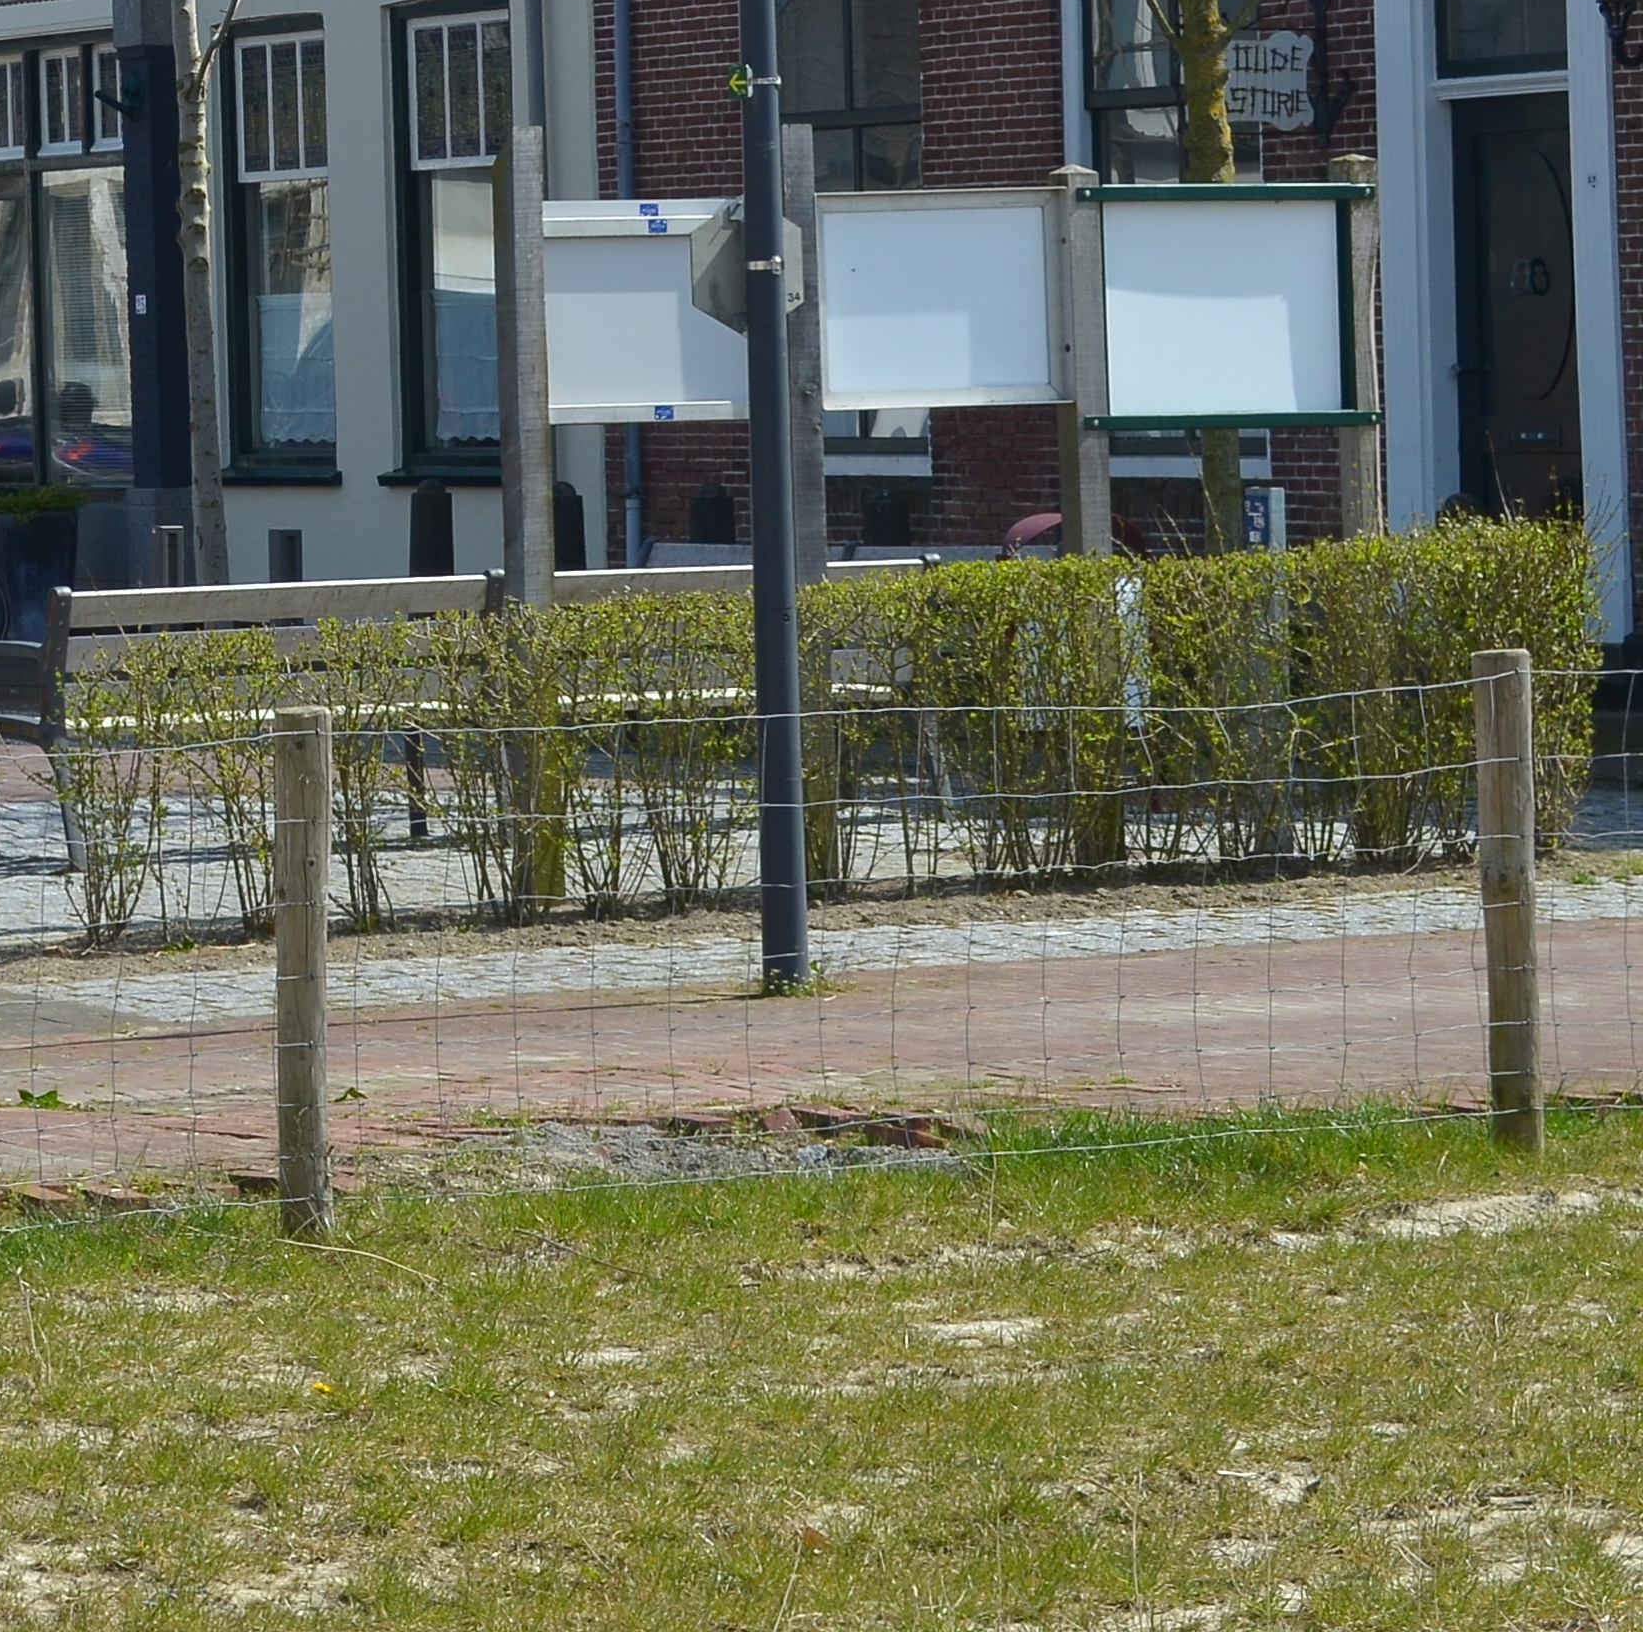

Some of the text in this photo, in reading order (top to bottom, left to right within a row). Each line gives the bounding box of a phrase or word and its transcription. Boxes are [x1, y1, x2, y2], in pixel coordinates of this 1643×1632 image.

[1232, 44, 1303, 74] OUDE
[1227, 86, 1308, 118] STORIE
[787, 292, 801, 303] 34
